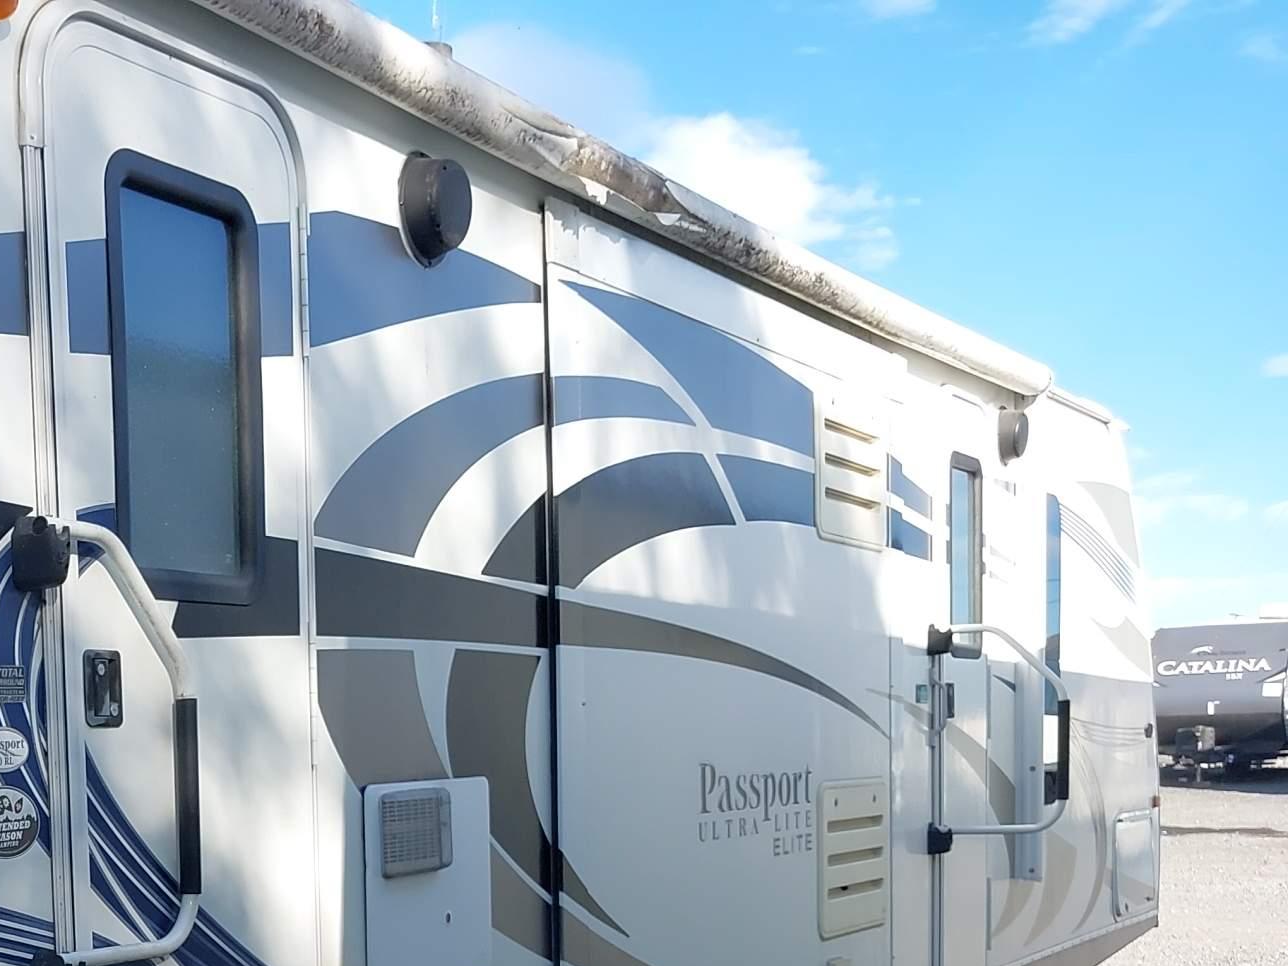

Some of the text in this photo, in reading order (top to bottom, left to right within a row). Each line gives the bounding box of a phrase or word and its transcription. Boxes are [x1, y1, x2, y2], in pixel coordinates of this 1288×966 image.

[1157, 657, 1272, 676] CATALINA
[698, 761, 813, 822] Passport
[698, 809, 812, 842] ULTRA LITE
[773, 833, 813, 856] ELITE
